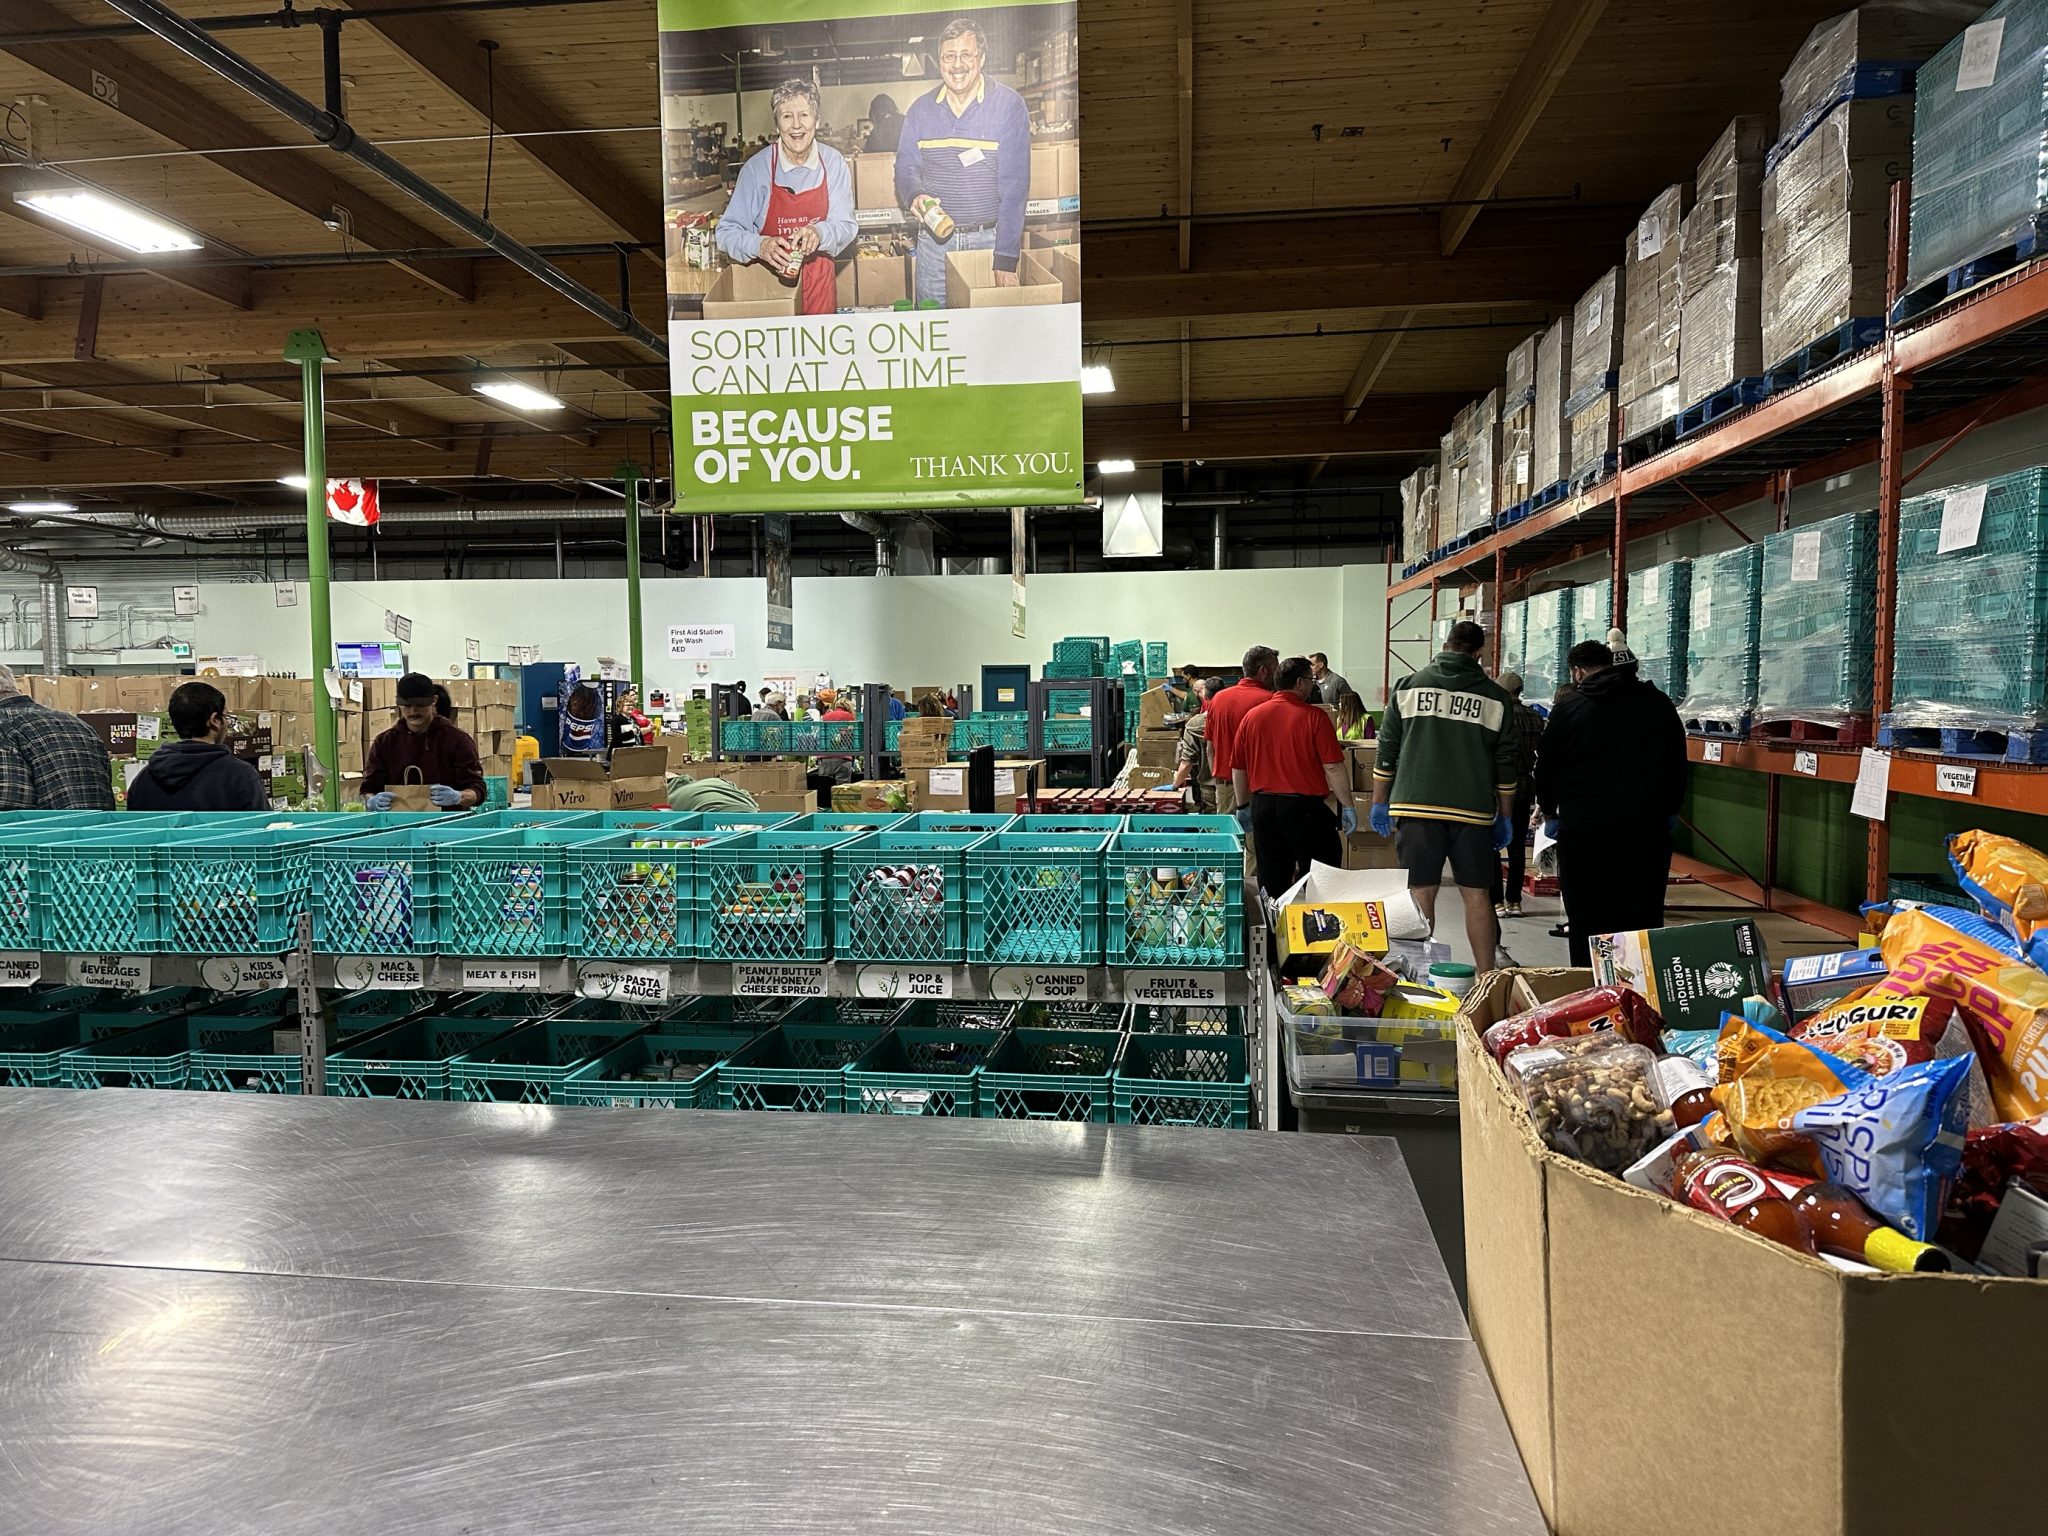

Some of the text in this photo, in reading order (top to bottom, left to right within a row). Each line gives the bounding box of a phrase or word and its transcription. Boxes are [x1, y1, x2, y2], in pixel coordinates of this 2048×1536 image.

[94, 75, 119, 107] 52
[777, 216, 799, 226] Have
[690, 320, 950, 362] SORTING ONE
[692, 355, 969, 396] CAN AT A TIME
[691, 405, 894, 446] BECAUSE
[694, 445, 861, 485] OF YOU.
[909, 450, 1075, 480] THANK YOU.
[699, 628, 723, 636] Station
[671, 637, 683, 645] Eye
[1416, 691, 1482, 719] EST. 1949
[1956, 781, 1972, 789] FRUIT
[558, 790, 585, 806] Viro
[614, 788, 634, 804] Viro
[1366, 903, 1381, 929] GLAD
[1741, 924, 1754, 957] KEURIG
[1598, 939, 1613, 959] 44
[100, 955, 122, 965] HOT
[249, 961, 274, 970] KIDS
[380, 961, 415, 972] MAC &
[738, 966, 822, 976] PEANUT BUTTER
[8, 969, 32, 979] HAM
[242, 969, 284, 982] SNACKS
[377, 970, 420, 983] CHEESE
[466, 969, 537, 980] MEAT & FISH
[744, 975, 815, 985] JAM/HONEY/
[908, 973, 943, 984] POP &
[1035, 974, 1085, 985] CANNED
[85, 976, 113, 988] (under
[625, 974, 661, 989] PASTA
[1149, 978, 1198, 989] FRUIT &
[1671, 956, 1690, 1014] NORDIQUE
[1684, 967, 1695, 999] MÉLANGE
[622, 984, 661, 999] SAUCE
[740, 984, 821, 995] CHEESE SPREAD
[909, 984, 943, 995] JUICE
[1044, 985, 1077, 996] SOUP
[1134, 988, 1215, 999] VEGETABLES
[2011, 1042, 2030, 1073] WHITE
